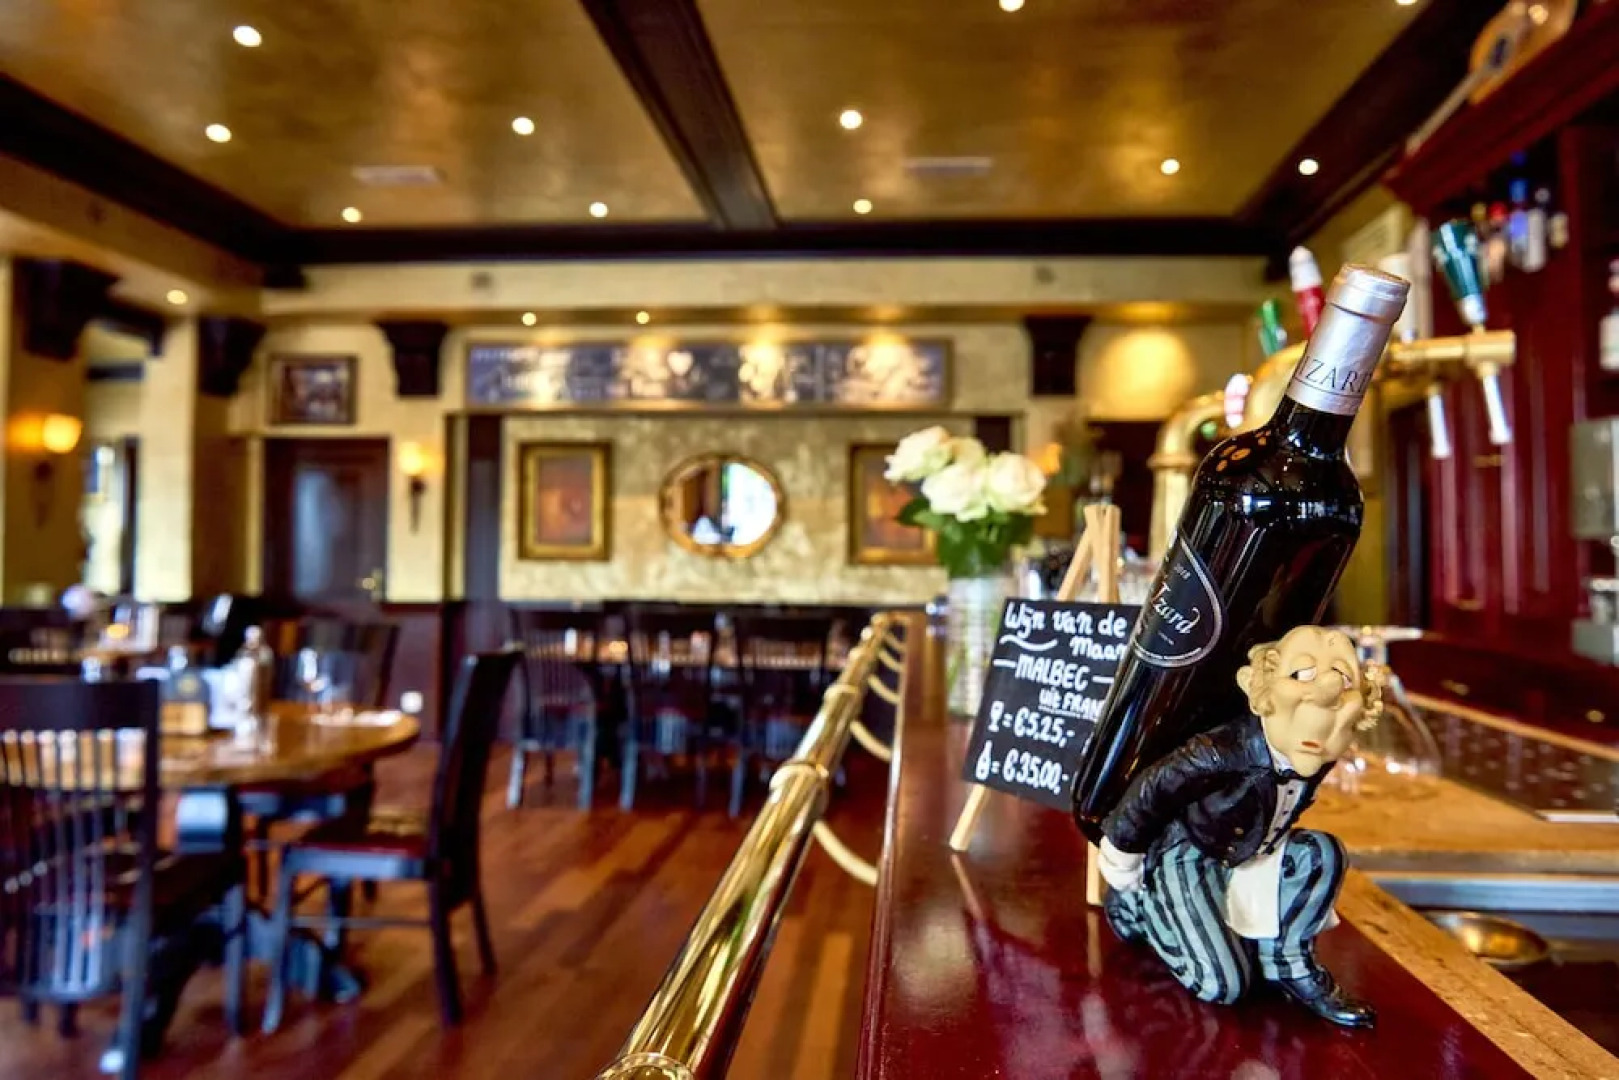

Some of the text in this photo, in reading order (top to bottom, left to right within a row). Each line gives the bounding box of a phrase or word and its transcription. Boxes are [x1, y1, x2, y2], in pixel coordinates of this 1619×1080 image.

[1004, 601, 1045, 639] Wijn
[1053, 610, 1094, 636] van
[1098, 609, 1128, 639] de
[1152, 582, 1201, 634] Izard
[1015, 652, 1091, 692] MALBEC
